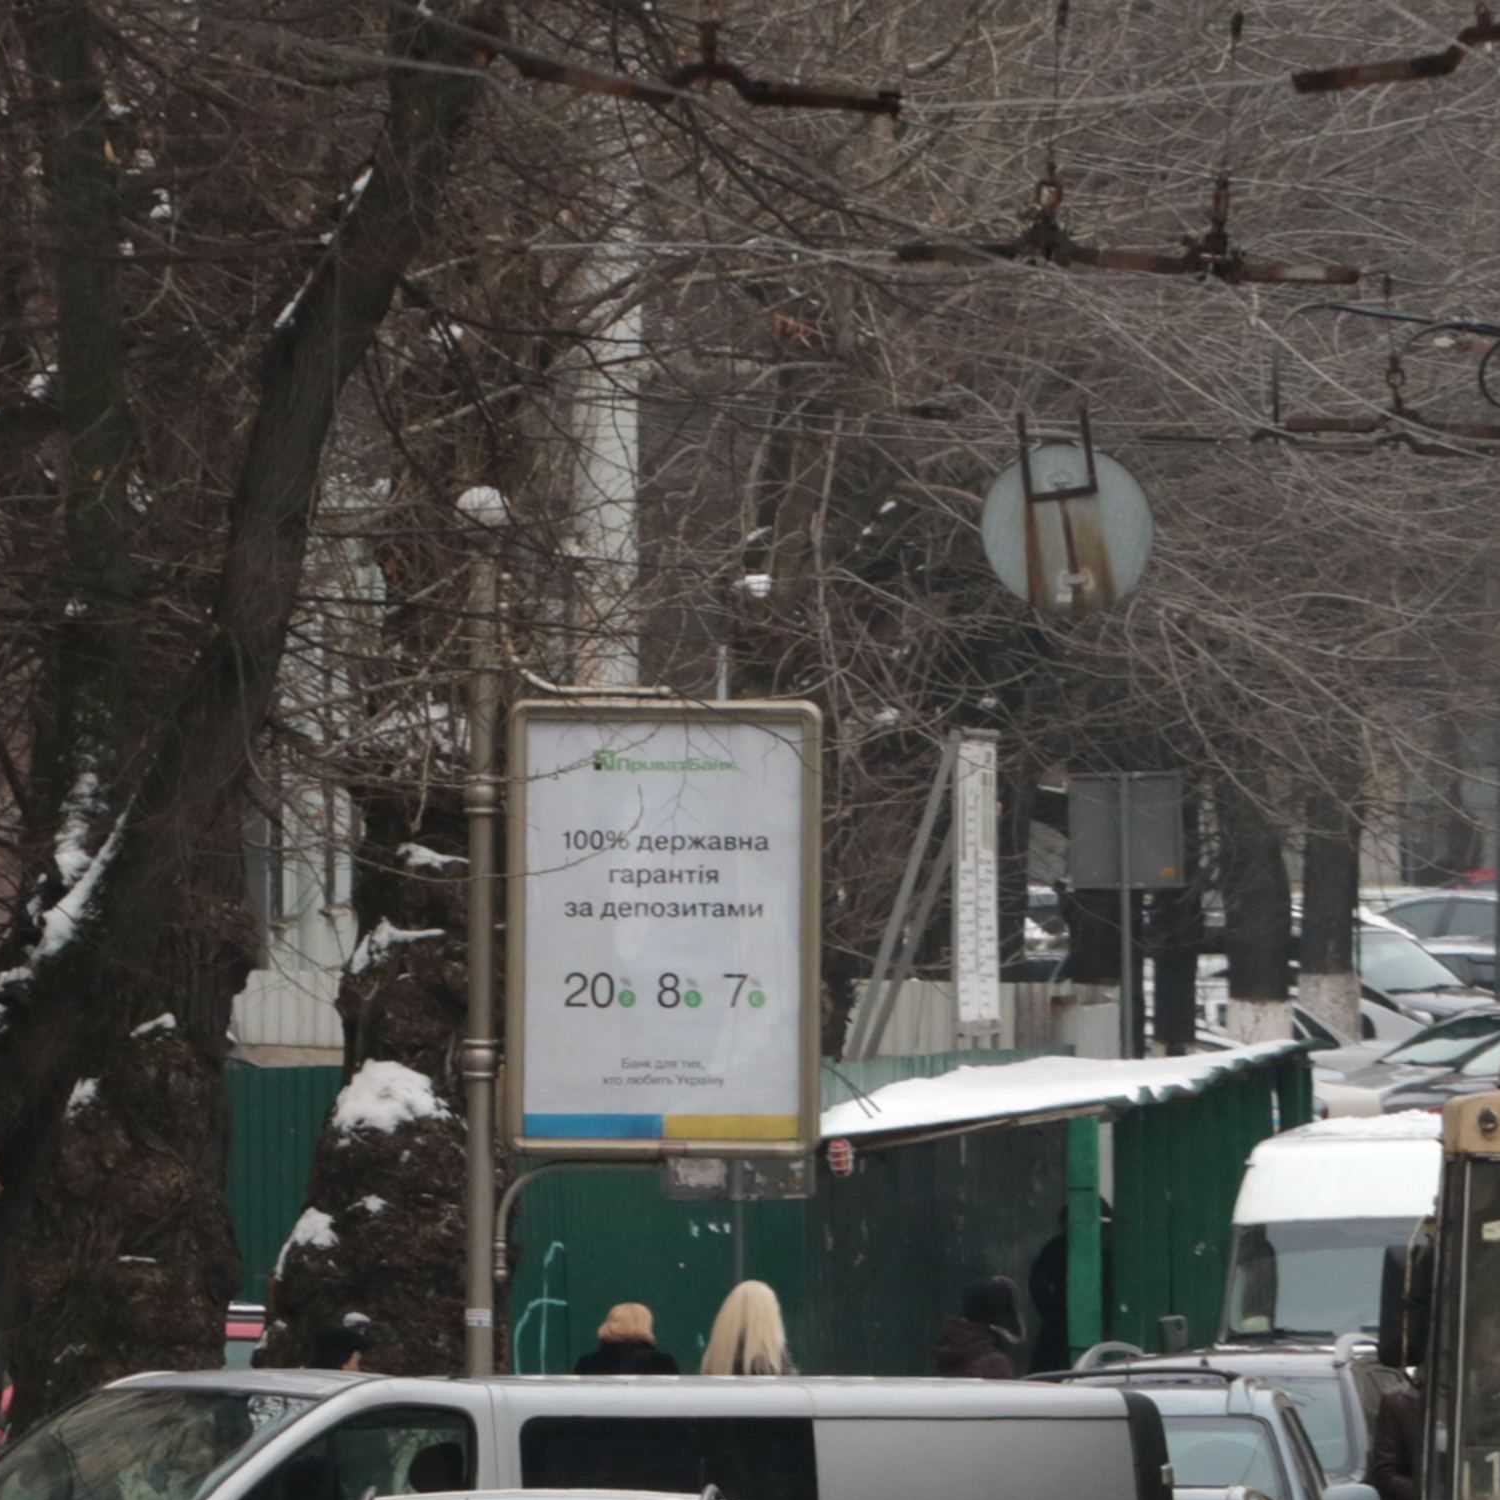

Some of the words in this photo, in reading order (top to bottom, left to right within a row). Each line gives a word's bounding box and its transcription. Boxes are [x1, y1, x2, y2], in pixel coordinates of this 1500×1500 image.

[563, 829, 630, 851] 100%
[635, 834, 769, 855] державна
[608, 864, 719, 888] гарантія
[564, 901, 594, 918] за
[600, 901, 764, 920] депозитами
[621, 1057, 651, 1069] Банк
[654, 1060, 677, 1070] для
[626, 1073, 673, 1086] любить
[675, 1074, 725, 1088] Україну
